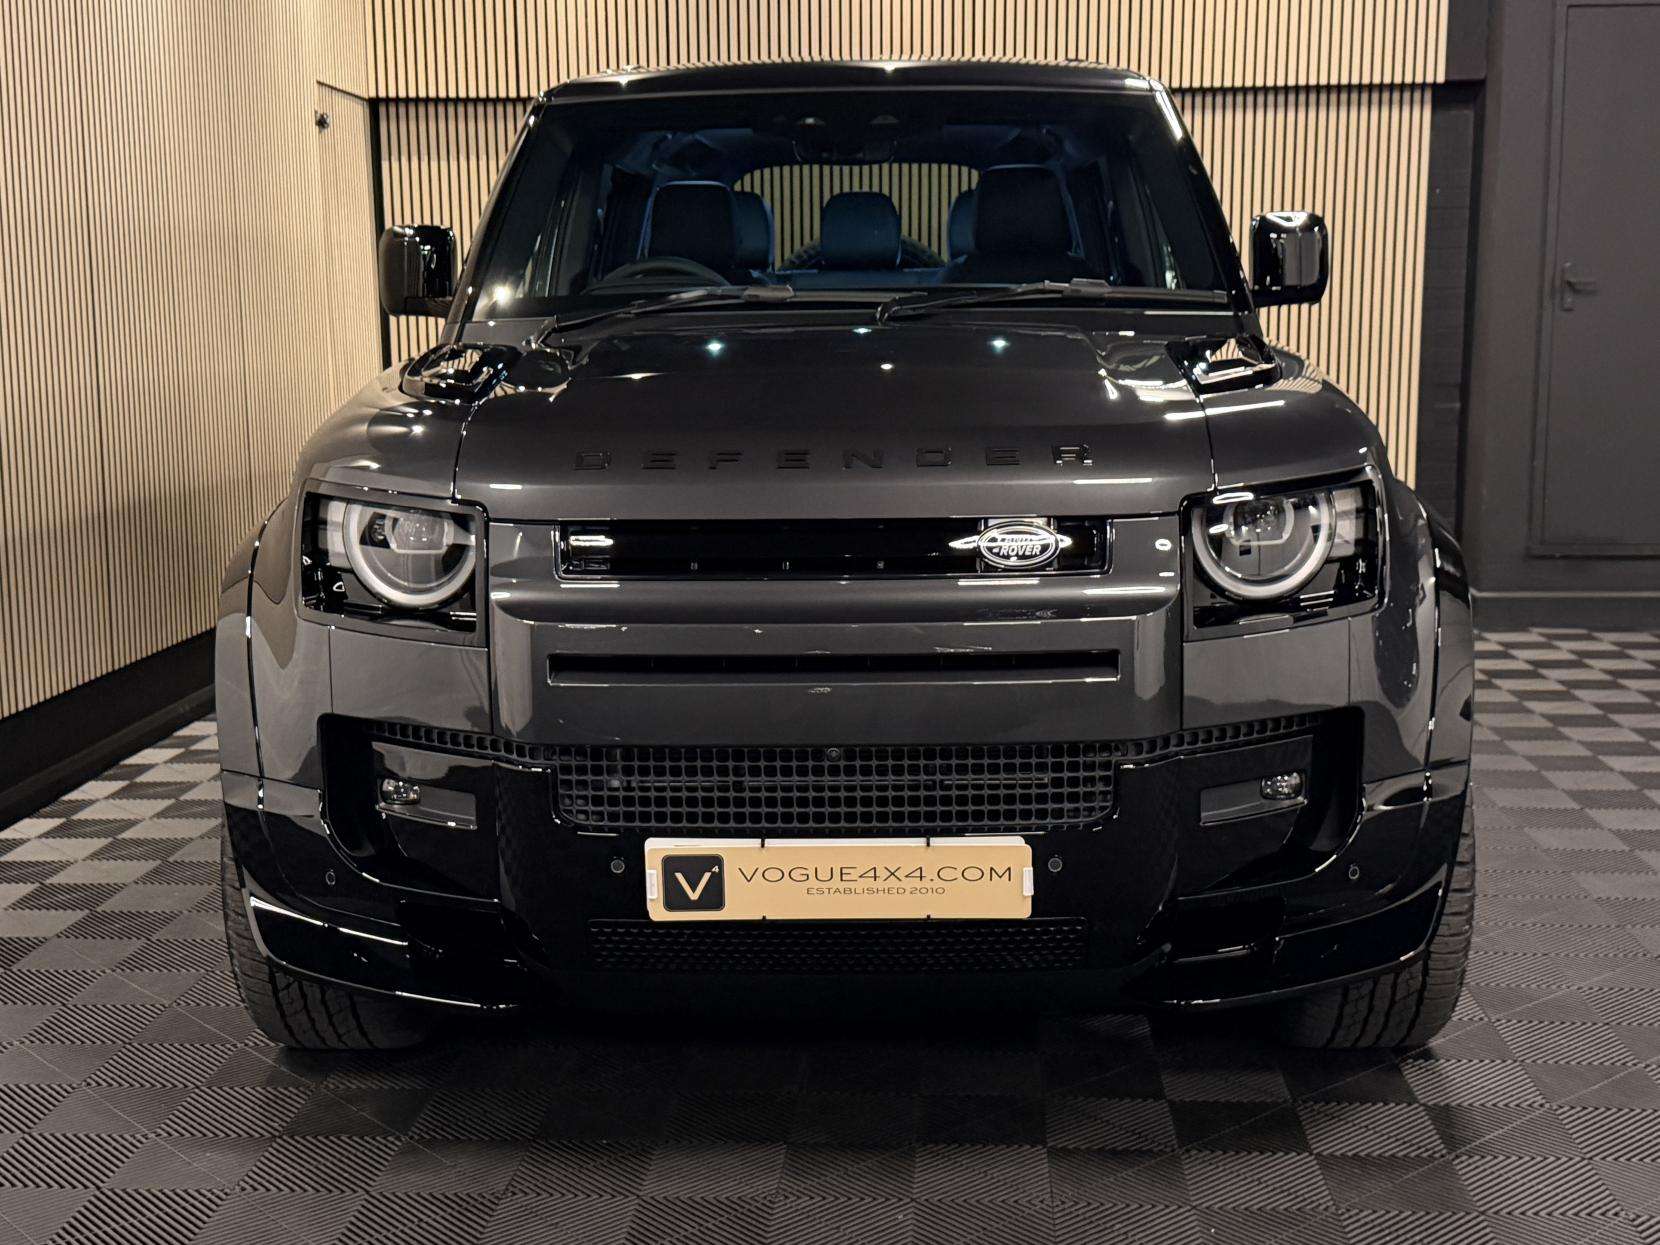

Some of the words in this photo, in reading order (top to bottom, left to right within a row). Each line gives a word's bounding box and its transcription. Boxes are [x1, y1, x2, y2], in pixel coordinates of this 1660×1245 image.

[575, 445, 1094, 470] DEFENDER
[999, 544, 1042, 556] ROVER
[738, 866, 1013, 882] VOGUE4X4.COM
[806, 886, 906, 896] ESTABLISHED
[909, 886, 946, 896] 2010
